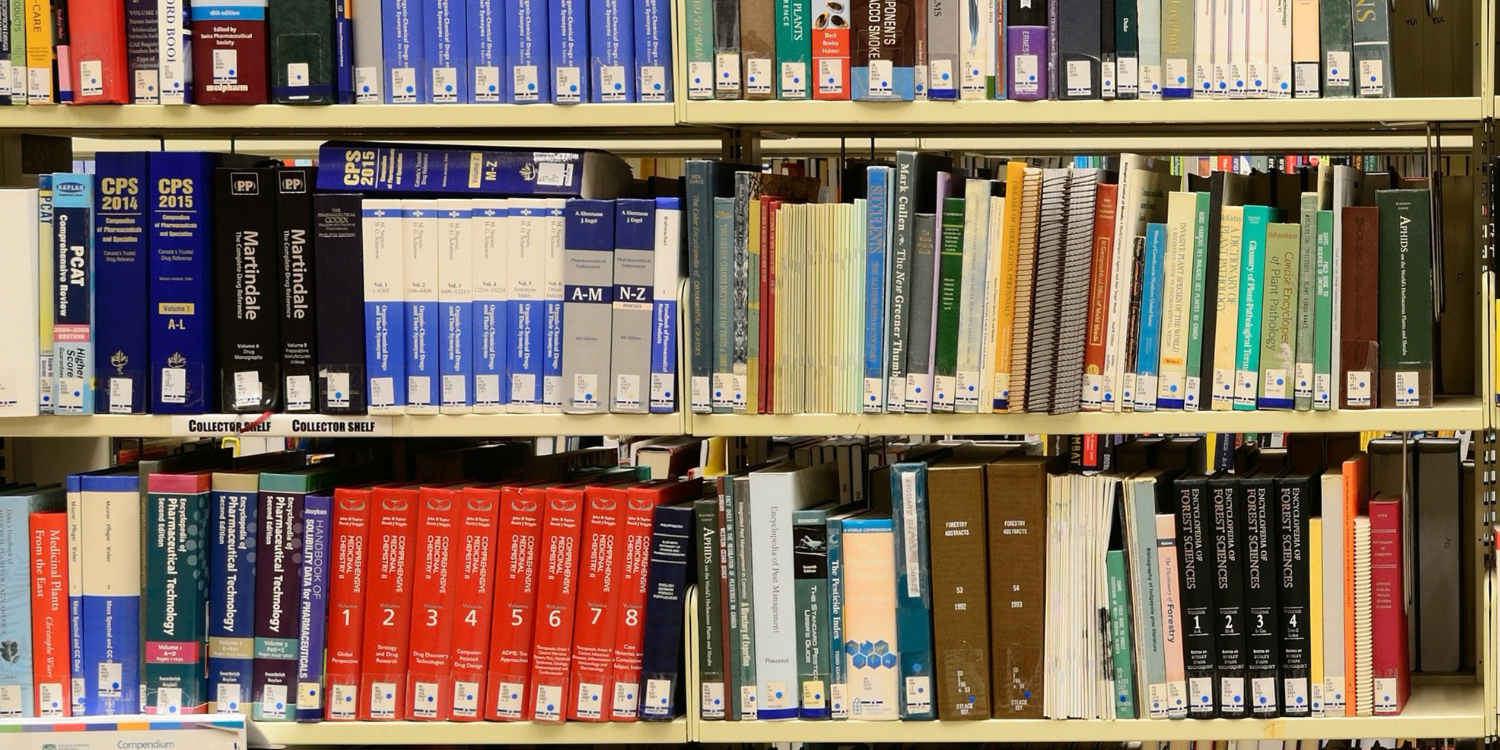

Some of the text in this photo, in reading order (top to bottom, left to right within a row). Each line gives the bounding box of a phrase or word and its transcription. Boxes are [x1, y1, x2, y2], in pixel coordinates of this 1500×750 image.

[793, 3, 803, 41] PLANTS
[868, 25, 880, 59] SMOKE
[344, 150, 360, 186] CPS
[361, 151, 375, 186] 2015
[899, 163, 910, 193] Mark
[101, 177, 139, 195] CPS
[158, 178, 193, 194] CPS
[158, 195, 193, 208] 2015
[41, 195, 53, 225] PCAT
[101, 196, 138, 210] 2014
[897, 196, 908, 231] Cullen
[58, 214, 69, 317] Comprehensive Review
[235, 243, 243, 273] Complete
[895, 249, 906, 270] The
[1004, 181, 1019, 317] DISEASES OF HERBACEOUS PERENNIALS
[1227, 225, 1239, 306] A DICTIONARY OF
[1246, 240, 1257, 272] Glossary
[70, 245, 85, 287] PCAT
[235, 273, 243, 289] Drug
[243, 230, 261, 320] Martindale
[291, 229, 309, 319] Martindale
[1217, 225, 1230, 314] PLANT PATHOLOGY
[1247, 273, 1256, 283] of
[1283, 252, 1294, 286] Concise
[572, 287, 603, 301] A-M
[620, 287, 646, 301] N-Z
[1266, 256, 1281, 351] of Plant Pathology
[893, 295, 905, 338] Greener
[66, 350, 75, 378] Score
[892, 340, 902, 377] Thumb
[188, 419, 242, 433] COLLECTOR
[292, 419, 375, 433] COLLECTOR SHELF
[177, 498, 187, 552] Encyclopedia of
[944, 529, 970, 537] ABSTRACTS
[1180, 489, 1196, 590] FOREST SCIENCES
[1191, 488, 1203, 562] ENCYCLOPEDIA OF
[35, 529, 46, 597] From the East
[163, 498, 179, 636] Pharmaceutical Technology
[223, 496, 239, 632] Pharmaceutical Technology
[313, 520, 324, 600] HANDBOOK OF
[338, 534, 347, 573] CHEMISTRY
[346, 535, 355, 574] MEDICINAL
[353, 535, 363, 593] COMPREHENSIVE
[769, 506, 780, 634] Encyclopedia of Pest Management
[50, 530, 62, 611] Medicinal Plants
[299, 519, 314, 679] SOLUBILITY DATA for PHARMACEUTICALS
[831, 560, 840, 640] The Pesticide Index
[956, 586, 964, 594] 53
[1012, 584, 1020, 592] 54
[342, 609, 351, 626] 1
[382, 609, 395, 626] 2
[426, 609, 438, 627] 3
[465, 609, 478, 627] 4
[511, 609, 523, 626] 5
[548, 610, 562, 628] 6
[590, 608, 602, 625] 7
[625, 609, 639, 626] 8
[1167, 603, 1175, 643] Forestry
[1193, 615, 1200, 629] 1
[1225, 615, 1233, 629] 2
[1256, 614, 1264, 629] 3
[1289, 614, 1298, 628] 4
